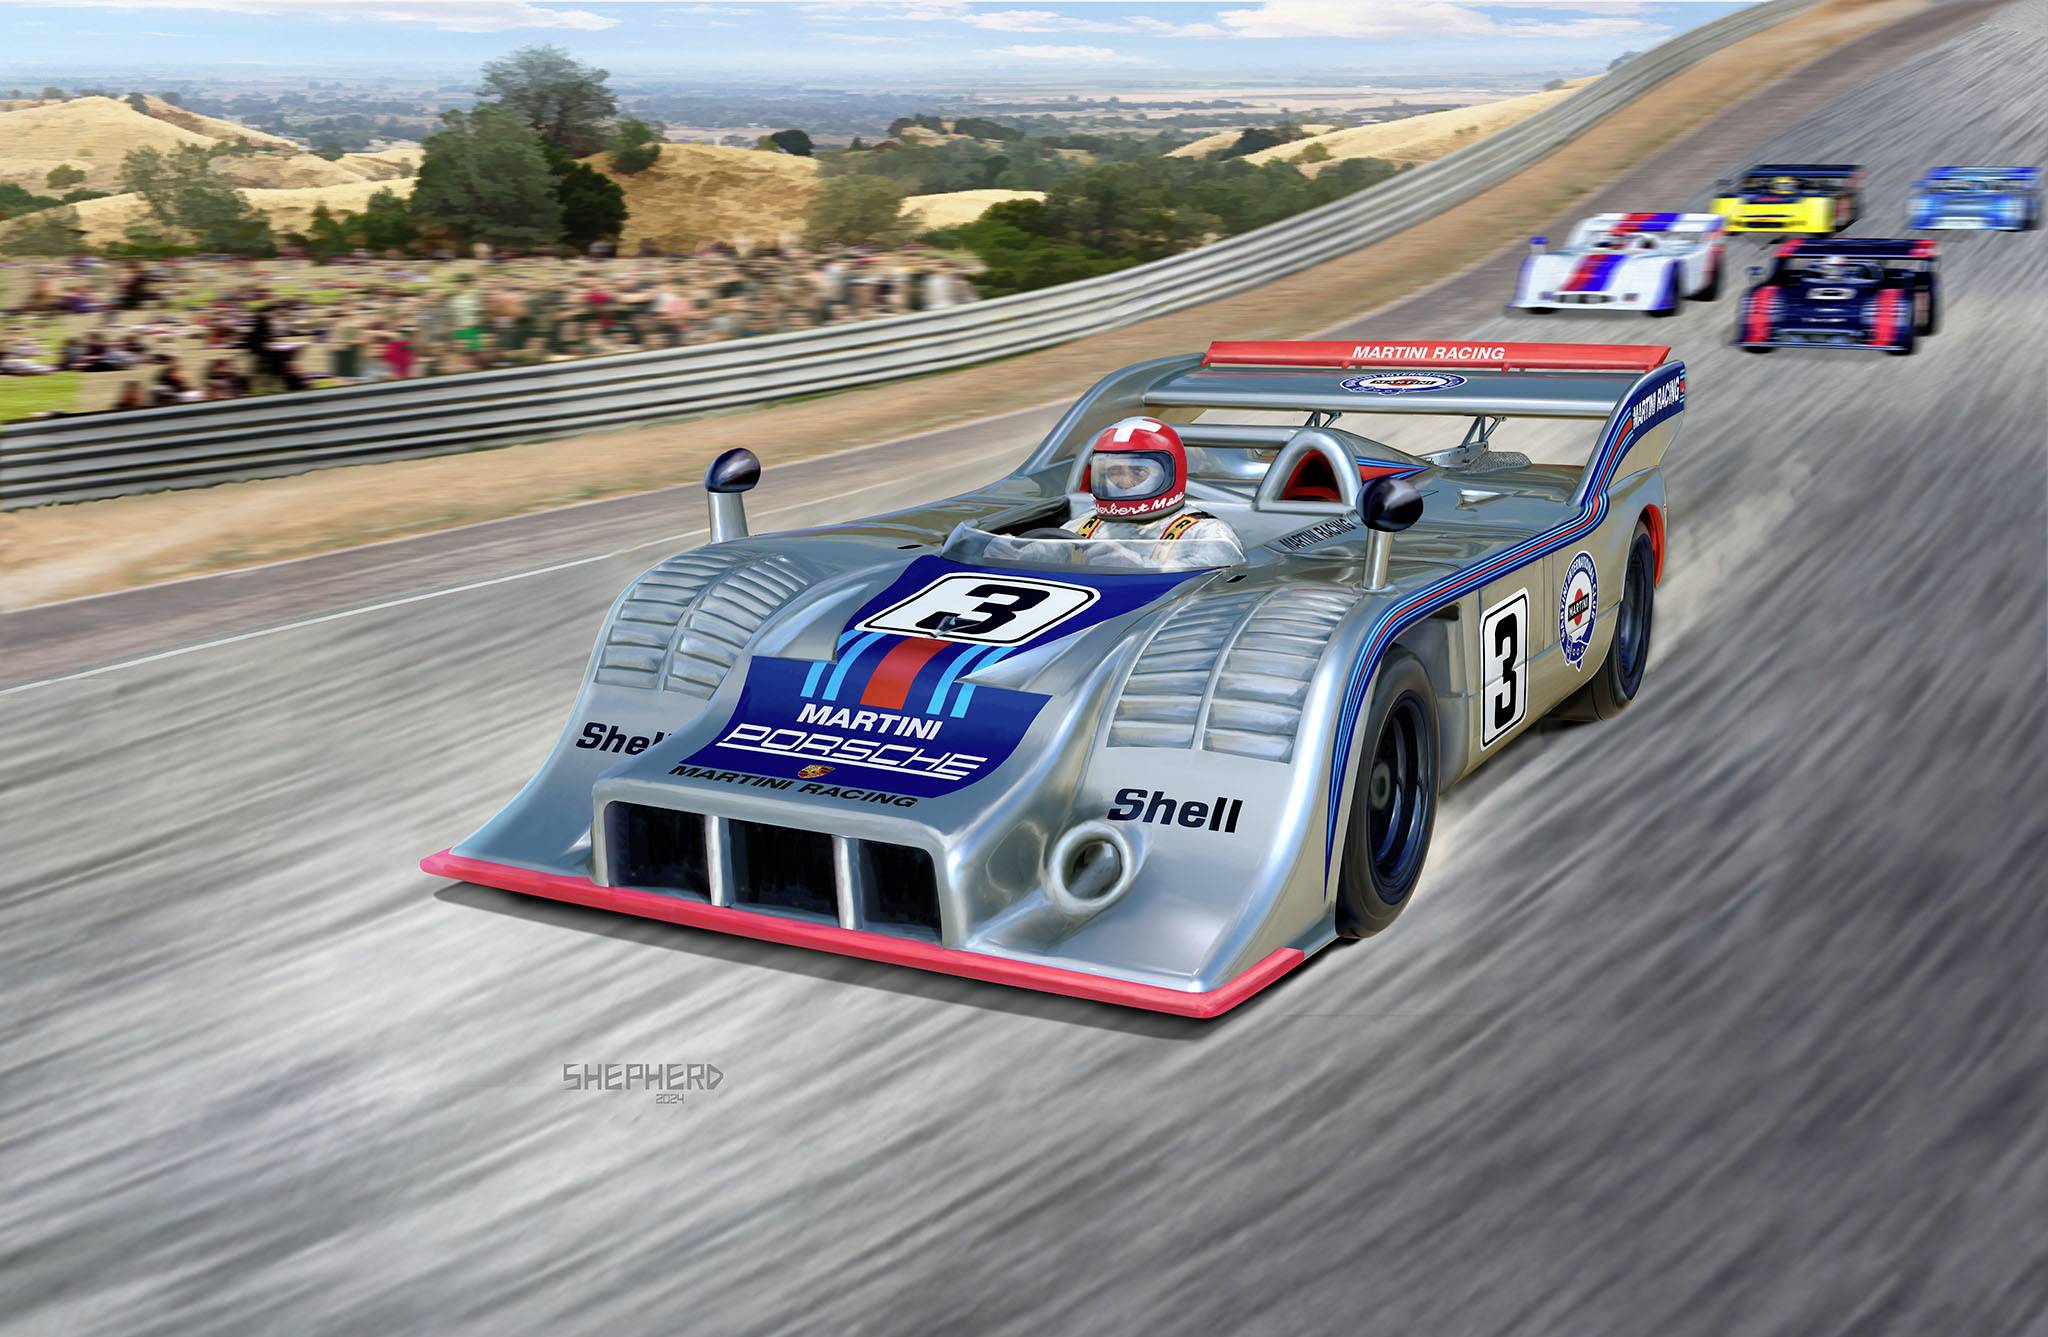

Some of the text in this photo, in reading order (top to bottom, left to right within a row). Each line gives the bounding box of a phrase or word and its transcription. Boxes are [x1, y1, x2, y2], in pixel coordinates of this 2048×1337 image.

[1352, 345, 1506, 361] MARTINI RACING
[1632, 375, 1680, 430] MARTINI RACING
[1279, 518, 1358, 552] MARTINI RACING
[915, 584, 1051, 634] 3
[1494, 612, 1518, 730] 3
[796, 702, 943, 742] MARTINI
[721, 722, 989, 777] PORSCHE
[668, 764, 920, 809] MARTINI RACING
[1107, 787, 1244, 833] Shell
